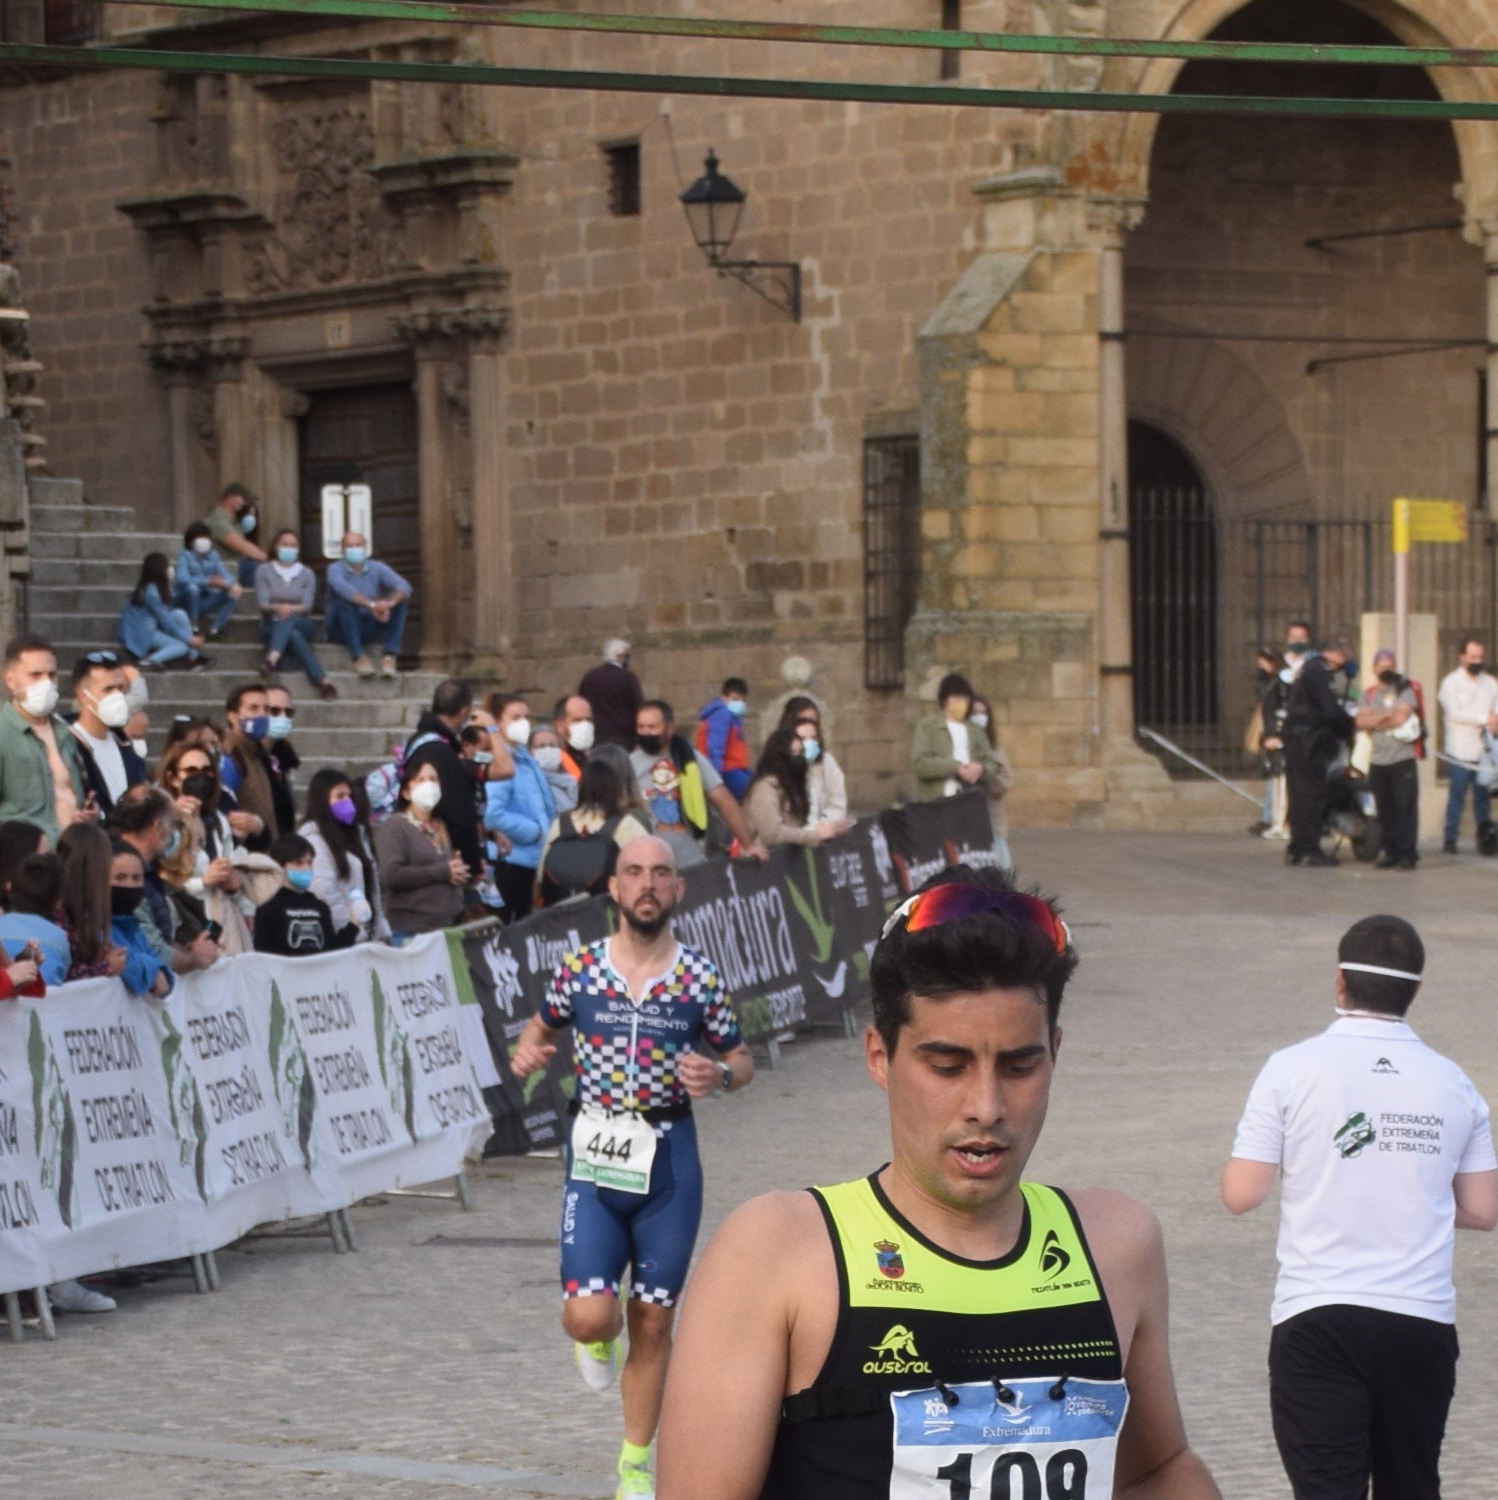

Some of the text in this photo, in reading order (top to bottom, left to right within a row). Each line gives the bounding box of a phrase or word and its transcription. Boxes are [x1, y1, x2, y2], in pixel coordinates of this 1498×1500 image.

[586, 1132, 633, 1164] 444
[1378, 1141, 1393, 1152] DE
[93, 1166, 121, 1213] DE
[862, 1360, 933, 1375] austral
[982, 1426, 1051, 1438] Extremadura
